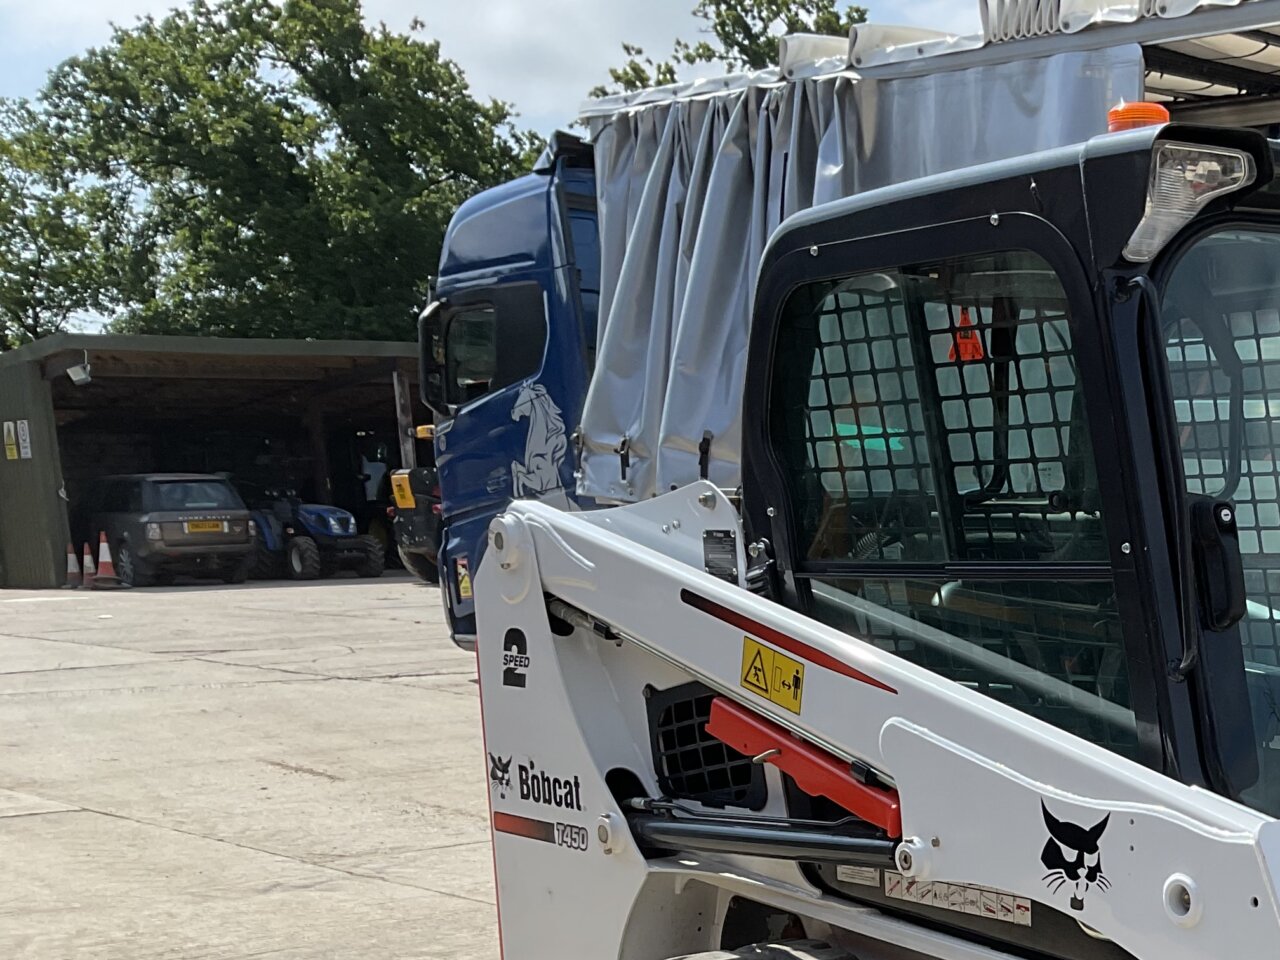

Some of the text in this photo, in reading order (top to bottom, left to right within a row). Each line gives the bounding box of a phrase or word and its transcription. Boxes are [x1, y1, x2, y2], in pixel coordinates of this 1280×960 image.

[502, 628, 527, 688] 2
[503, 654, 530, 668] SPEED
[518, 762, 582, 811] Bobcat
[556, 822, 589, 852] T450
